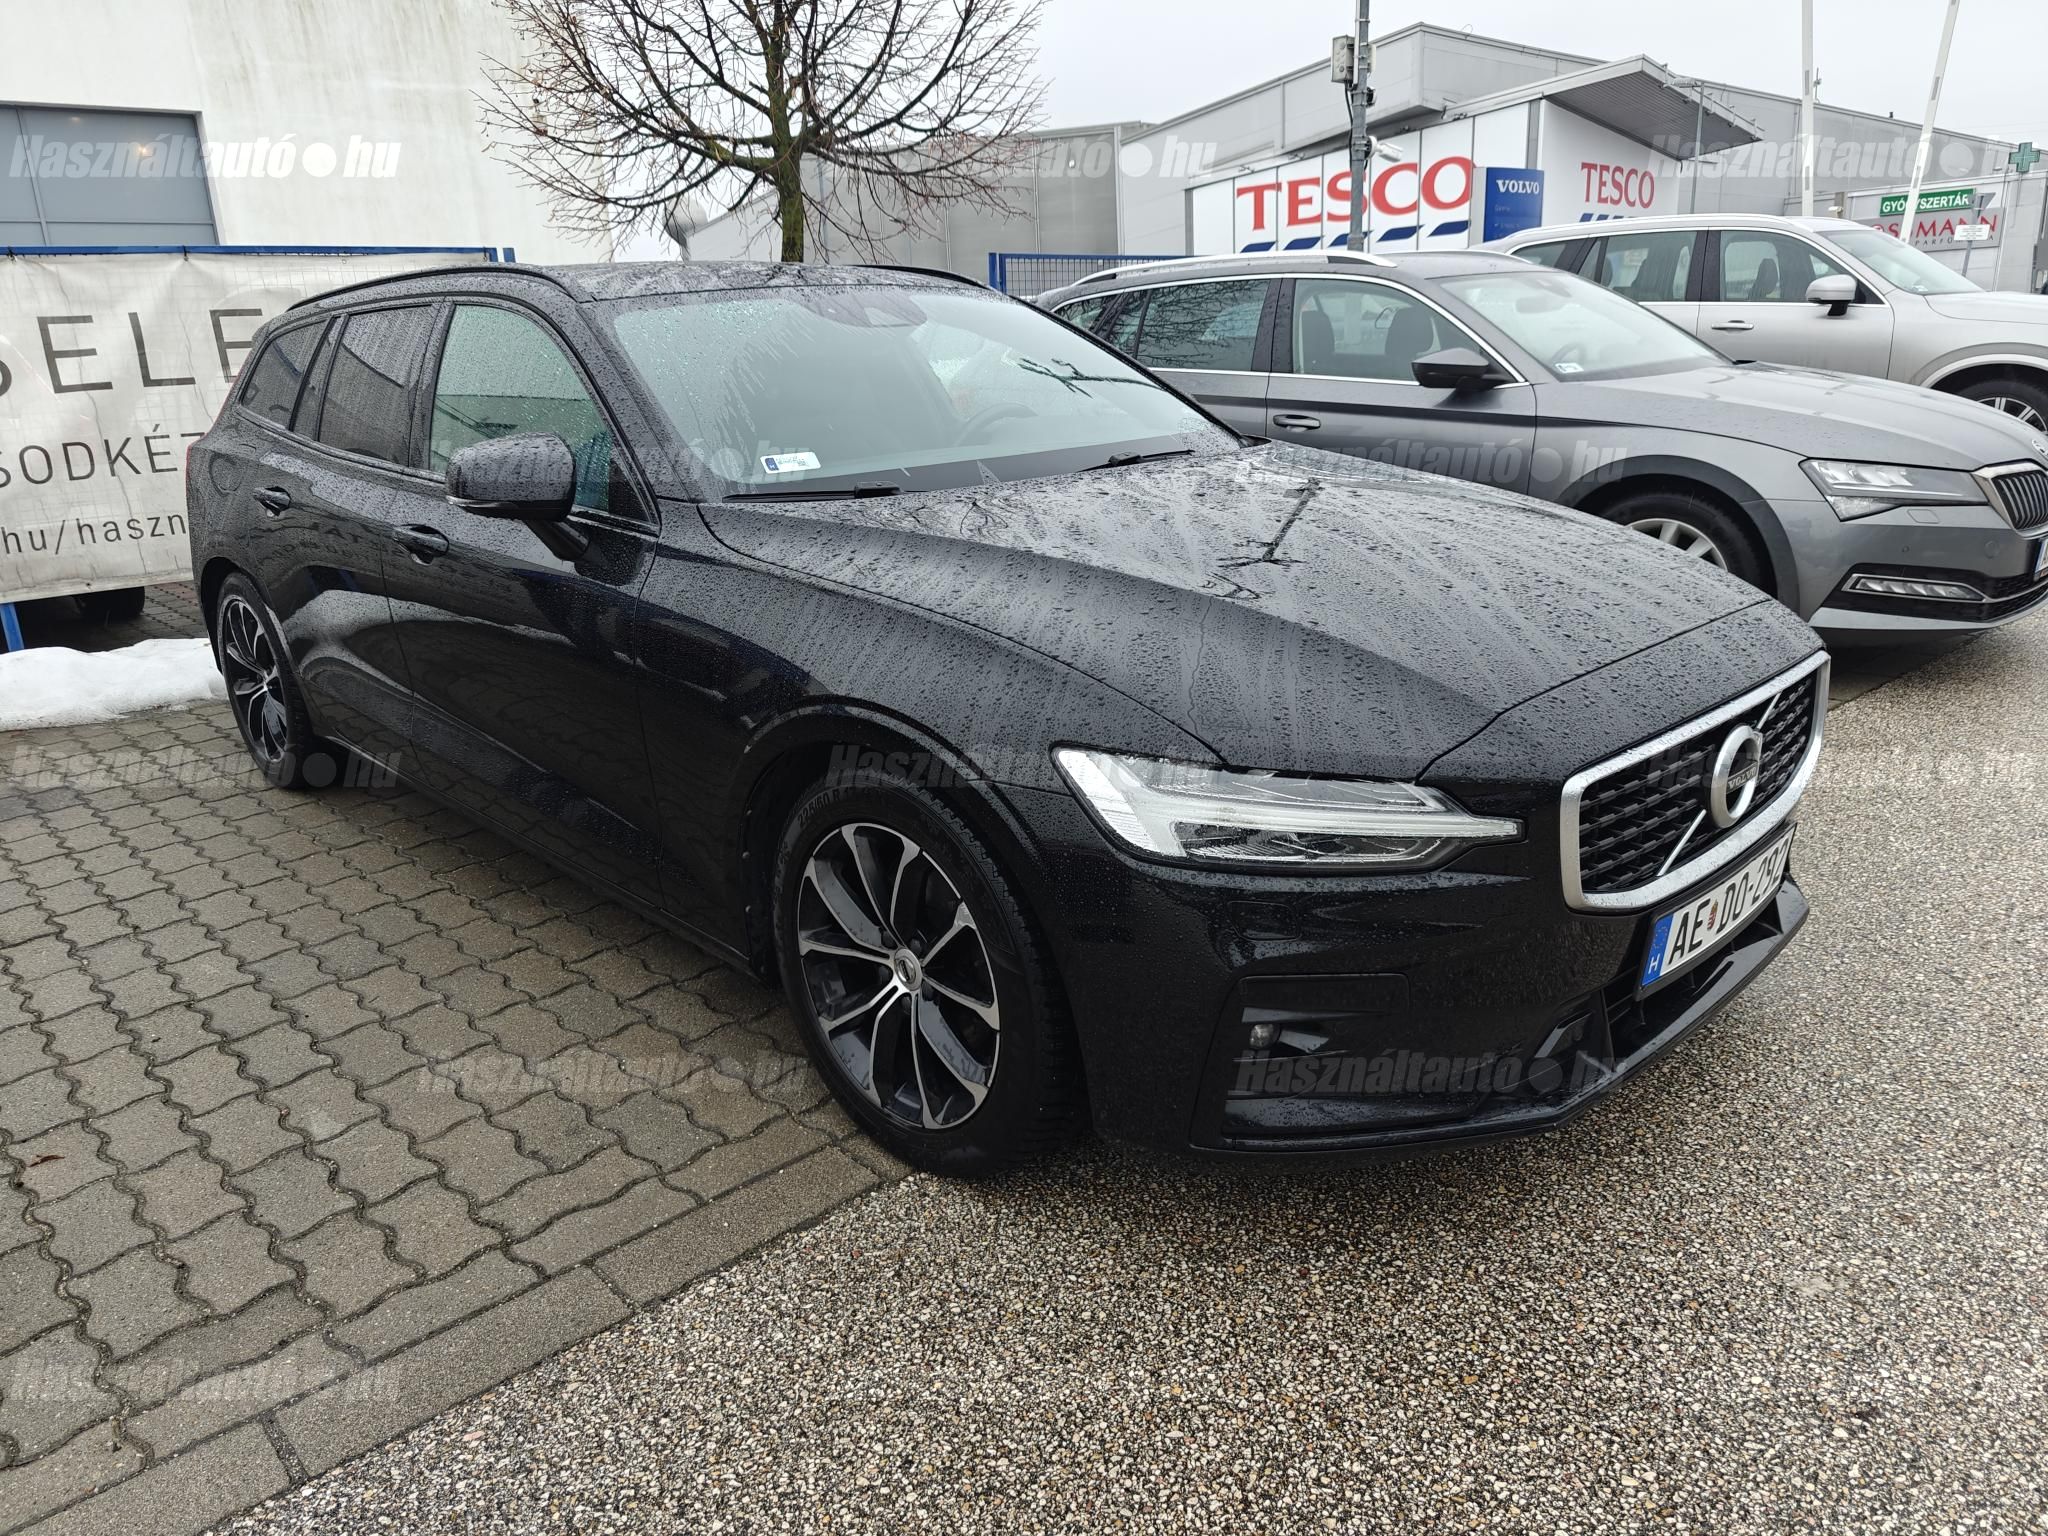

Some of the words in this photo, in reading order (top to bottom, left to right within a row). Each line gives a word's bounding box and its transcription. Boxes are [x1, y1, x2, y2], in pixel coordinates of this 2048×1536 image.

[1236, 155, 1476, 231] TESCO
[1496, 179, 1540, 195] VOLVO
[1581, 161, 1655, 209] TESCO
[1882, 192, 1969, 213] GYÓSZERTÁR
[0, 308, 263, 397] ELE
[0, 424, 205, 489] ODKÉ
[1727, 766, 1758, 790] VOLVO
[1648, 953, 1661, 975] H
[1668, 898, 1711, 966] AE
